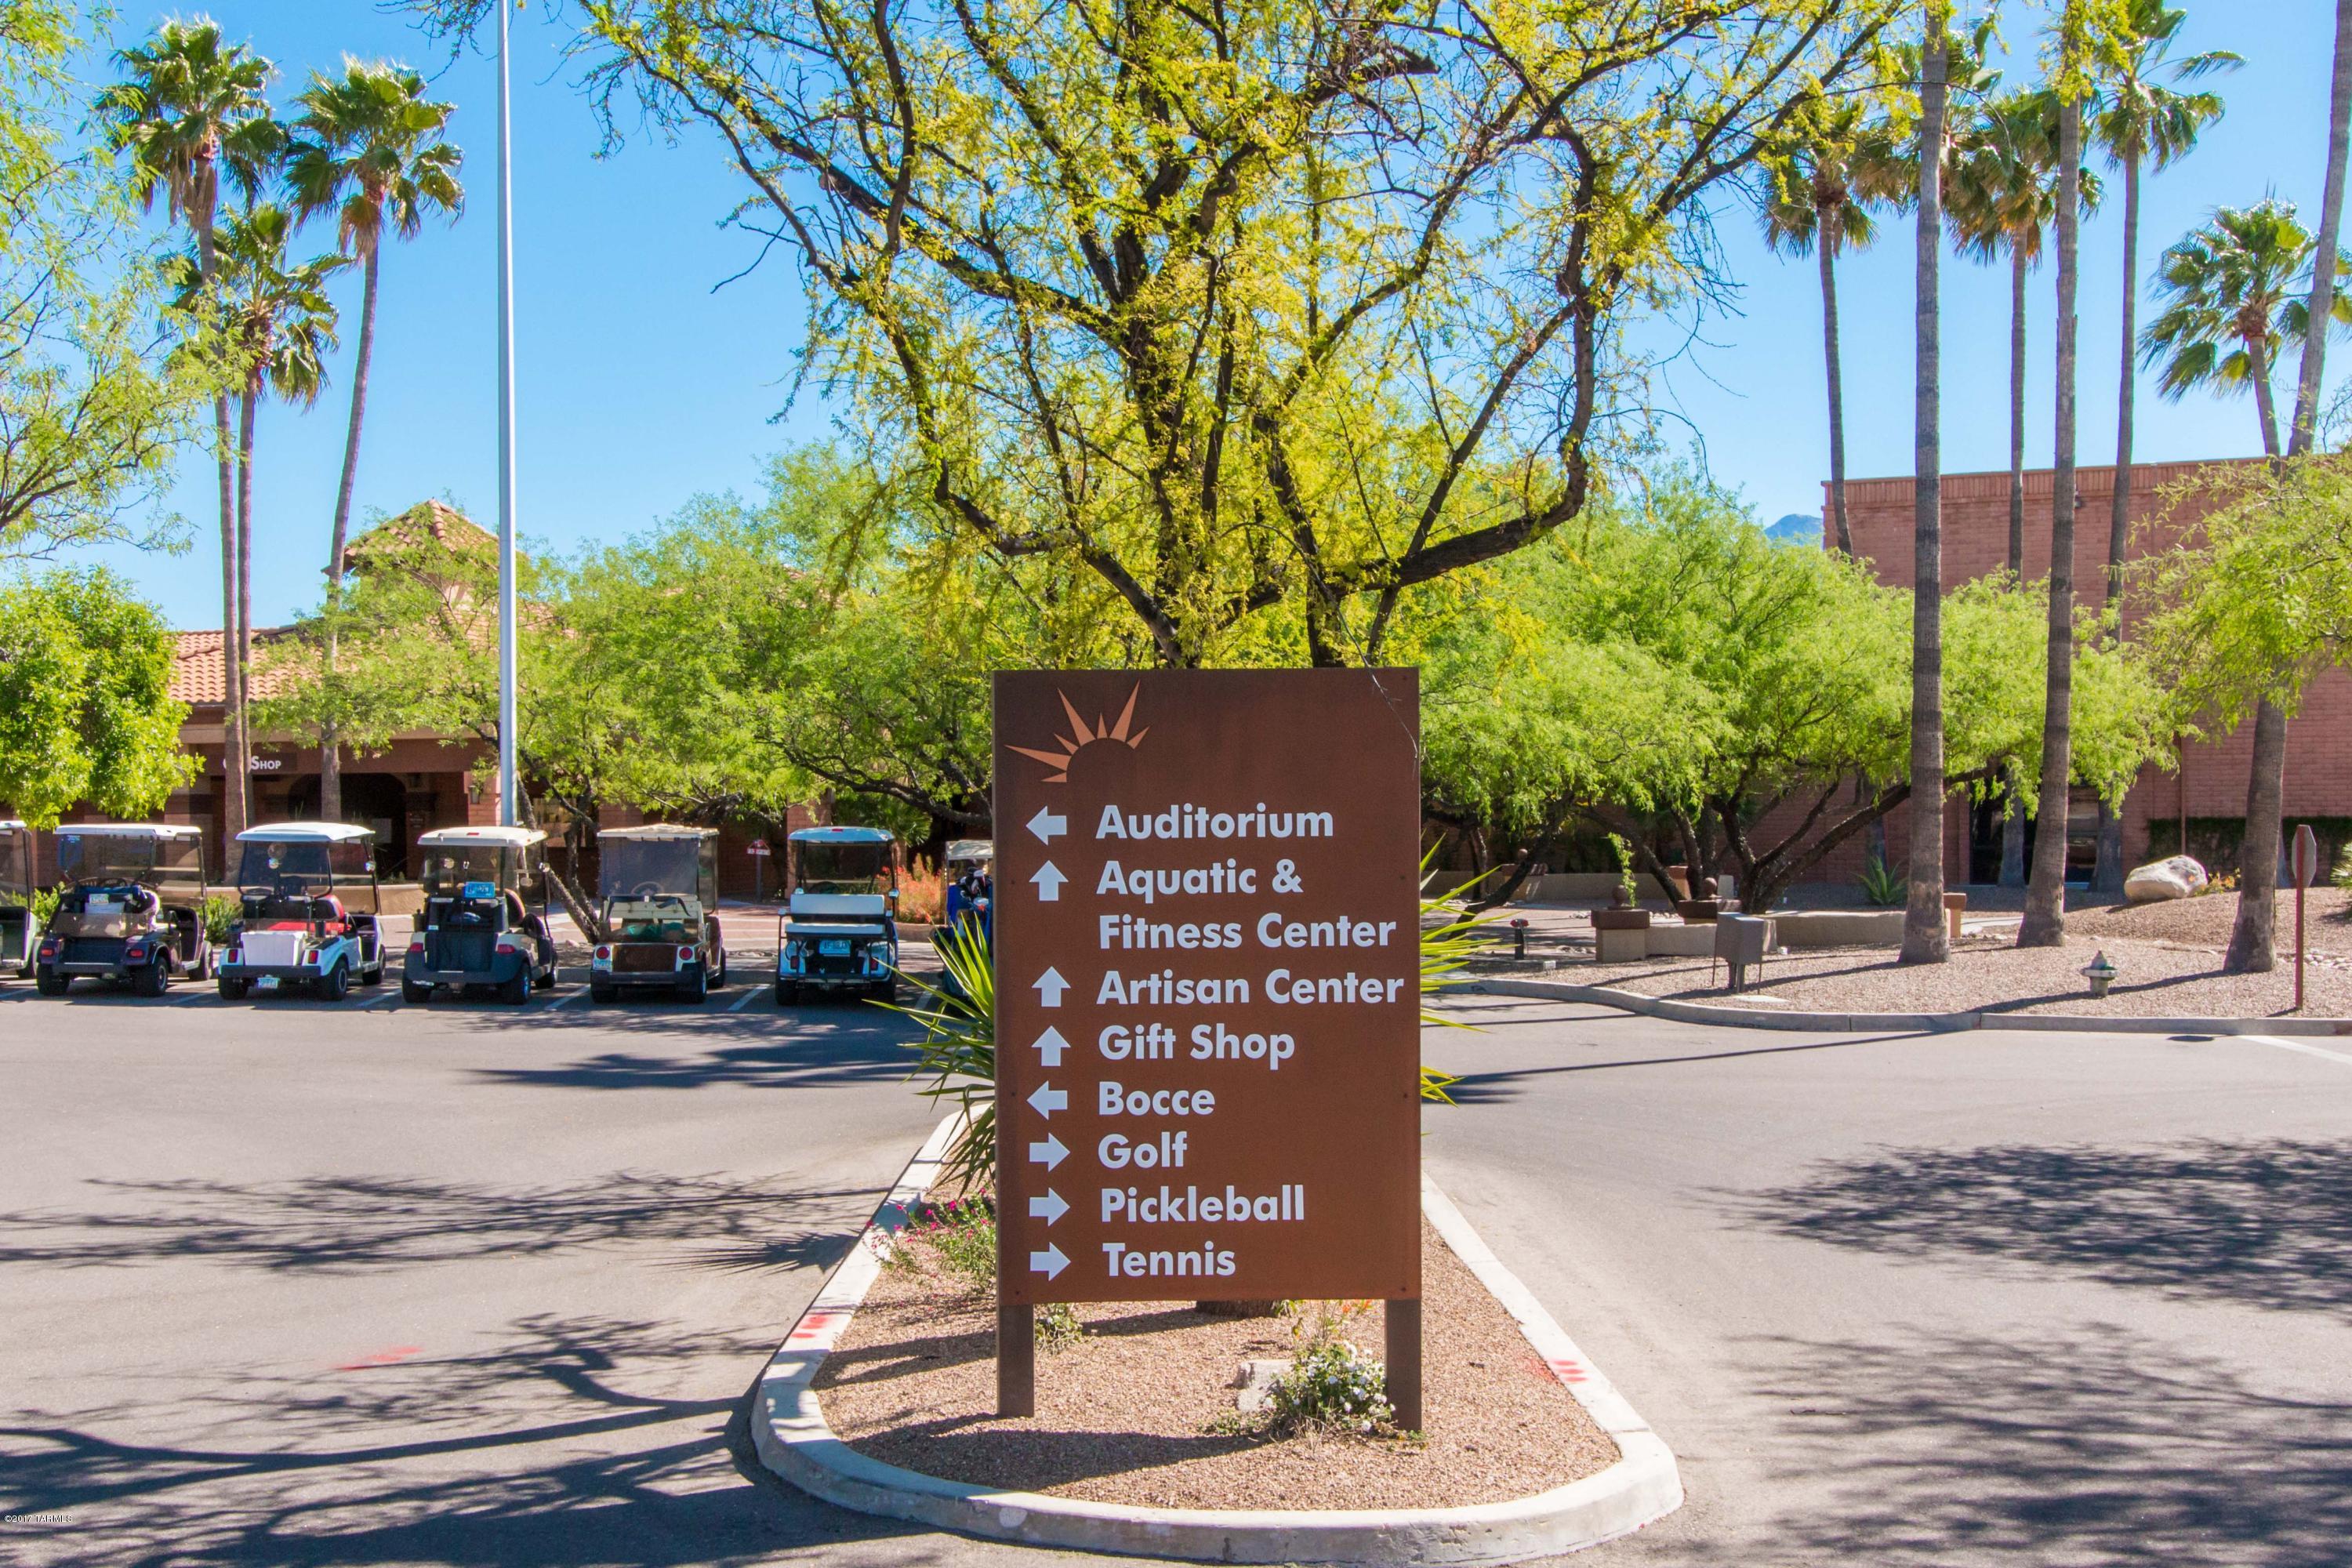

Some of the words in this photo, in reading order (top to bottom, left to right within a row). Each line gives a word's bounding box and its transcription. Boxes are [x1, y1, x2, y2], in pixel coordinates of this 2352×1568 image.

[1096, 803, 1334, 839] Auditorium
[1096, 858, 1256, 904] Aquatic
[1272, 859, 1303, 894] &
[1099, 913, 1242, 949] Fitness
[1258, 913, 1396, 948] Center
[1096, 969, 1250, 1004] Artisan
[1265, 969, 1404, 1004] Center
[1098, 1022, 1176, 1060] Gift
[1190, 1022, 1295, 1070] Shop
[1098, 1081, 1215, 1116] Bocce
[1098, 1131, 1188, 1168] Golf
[1102, 1184, 1305, 1223] Pickleball
[1102, 1241, 1236, 1277] Tennis
